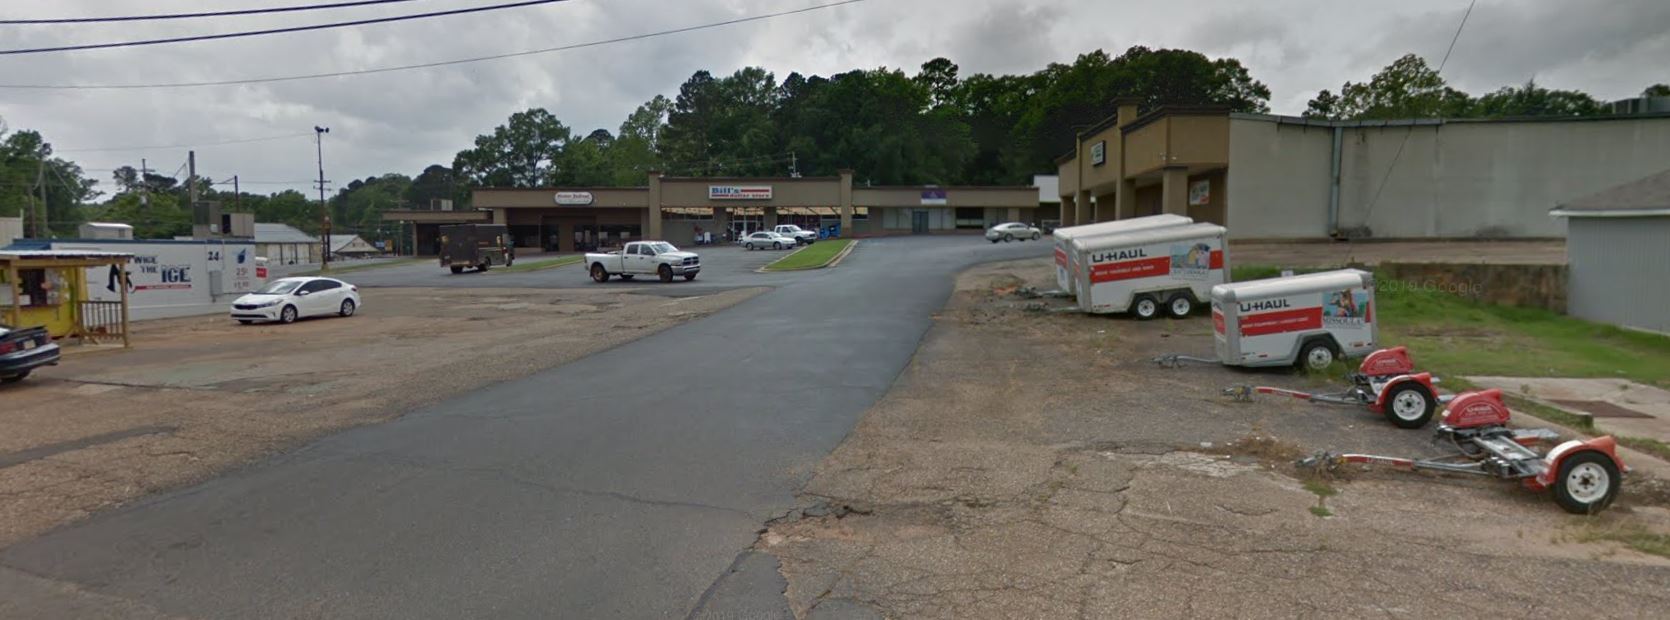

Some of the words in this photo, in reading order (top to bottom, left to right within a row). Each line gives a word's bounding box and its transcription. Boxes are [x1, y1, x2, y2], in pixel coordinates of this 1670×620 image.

[208, 251, 220, 261] 24
[1092, 248, 1147, 263] U-HAUL
[141, 266, 158, 274] THE
[161, 267, 192, 283] ICE
[1240, 299, 1291, 312] U-HAUL
